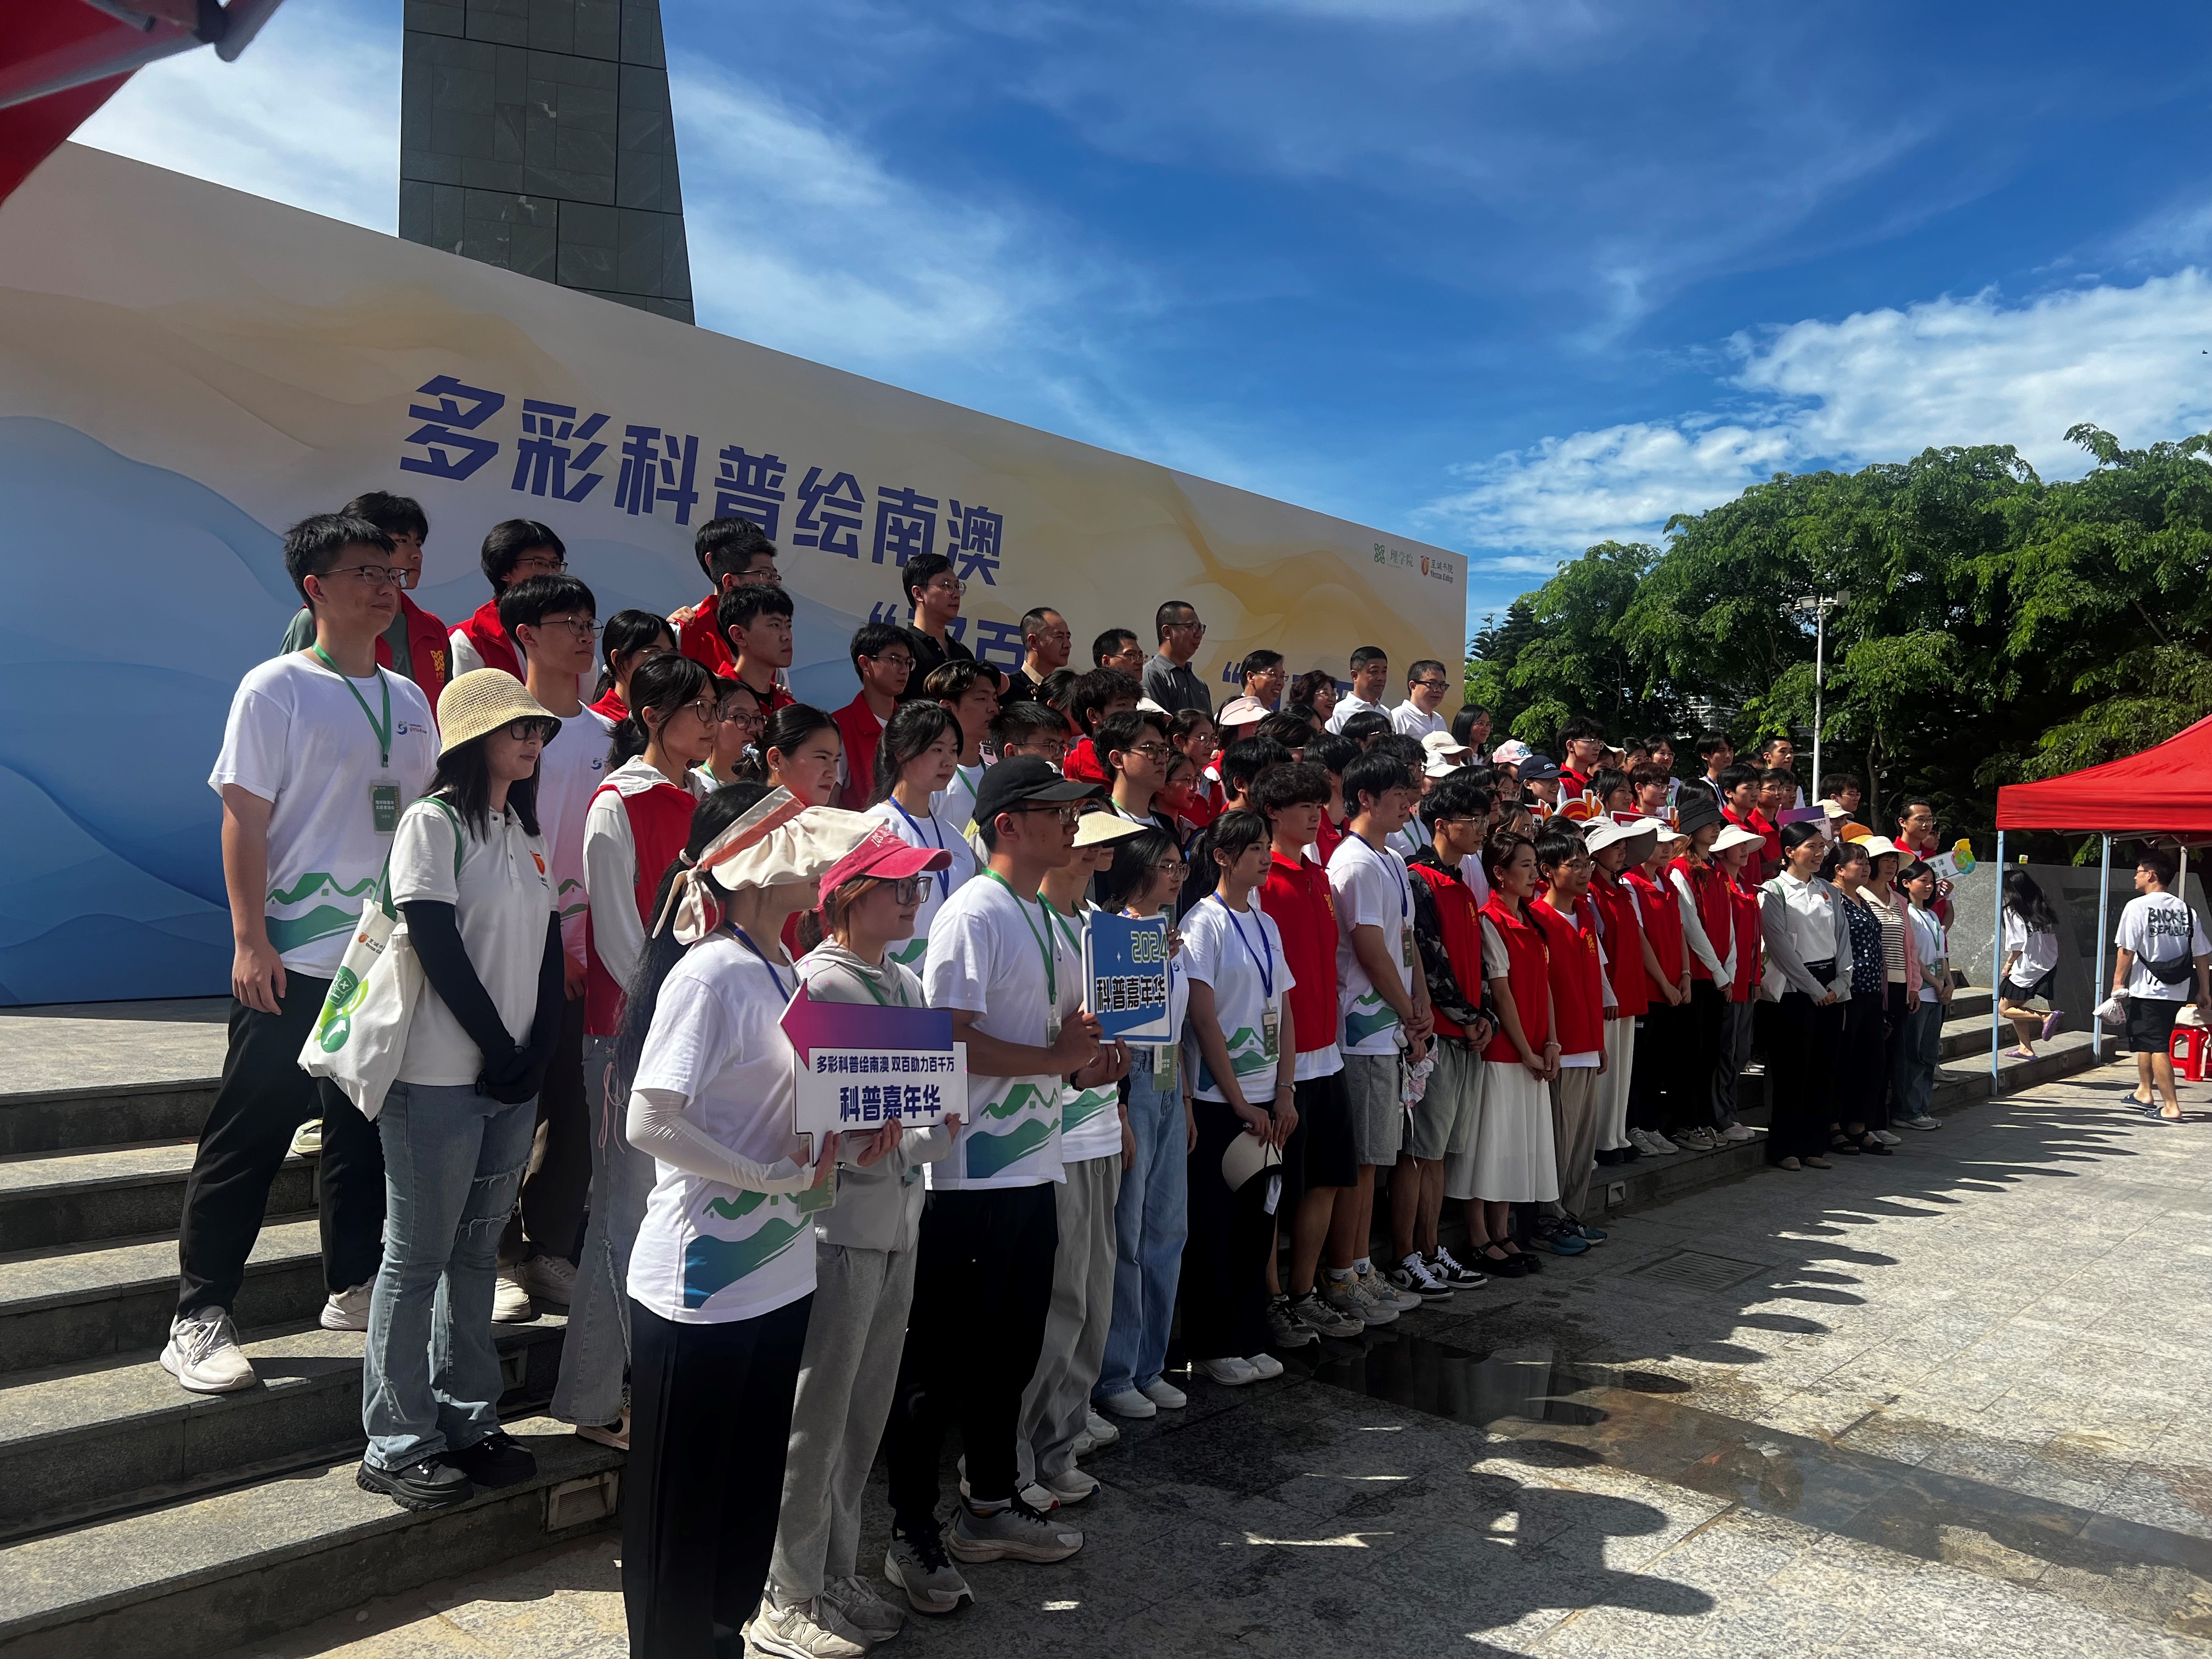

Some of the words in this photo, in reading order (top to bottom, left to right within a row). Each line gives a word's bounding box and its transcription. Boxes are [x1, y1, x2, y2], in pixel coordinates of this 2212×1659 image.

[400, 375, 1003, 586] 多彩科普绘南澳
[1390, 549, 1413, 567] 理学院
[1131, 930, 1169, 963] 2024
[1096, 973, 1166, 1014] 科普嘉年华
[816, 1055, 890, 1074] 多彩科普绘南澳
[891, 1056, 955, 1073] 双百助力百千万
[839, 1084, 941, 1122] 科普嘉年华
